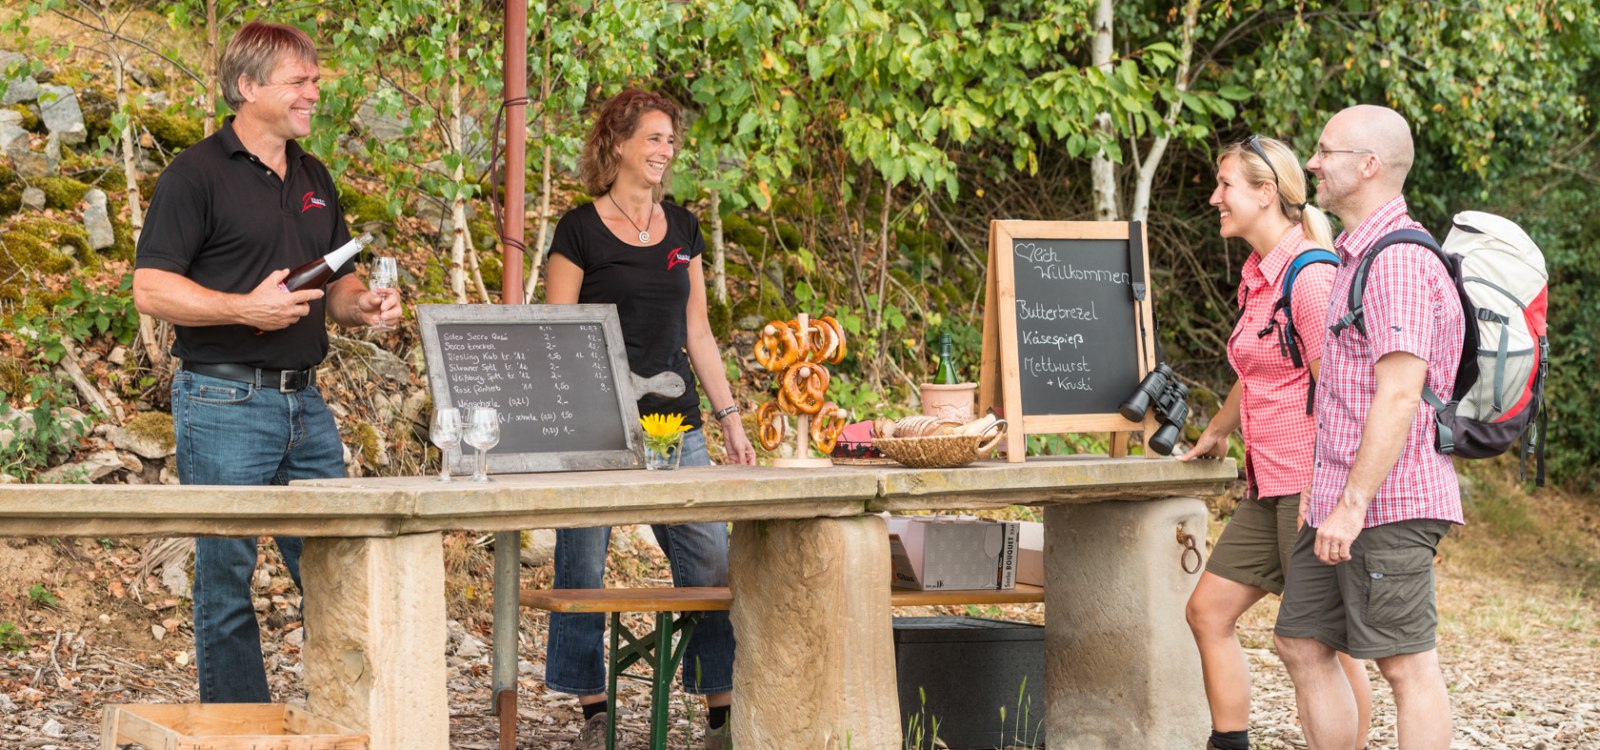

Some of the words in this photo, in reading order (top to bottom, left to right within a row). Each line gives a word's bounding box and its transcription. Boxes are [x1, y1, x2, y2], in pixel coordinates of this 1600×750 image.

[1034, 264, 1130, 284] Willkommen
[1016, 300, 1098, 321] Butterbrezel
[444, 342, 465, 350] Secco
[447, 352, 480, 364] Riesling
[449, 364, 478, 372] Silvaner
[1024, 356, 1092, 378] Mettwurst
[1058, 376, 1093, 390] Krusti
[457, 397, 500, 408] Weinschorle
[1006, 536, 1014, 570] BOUQUET
